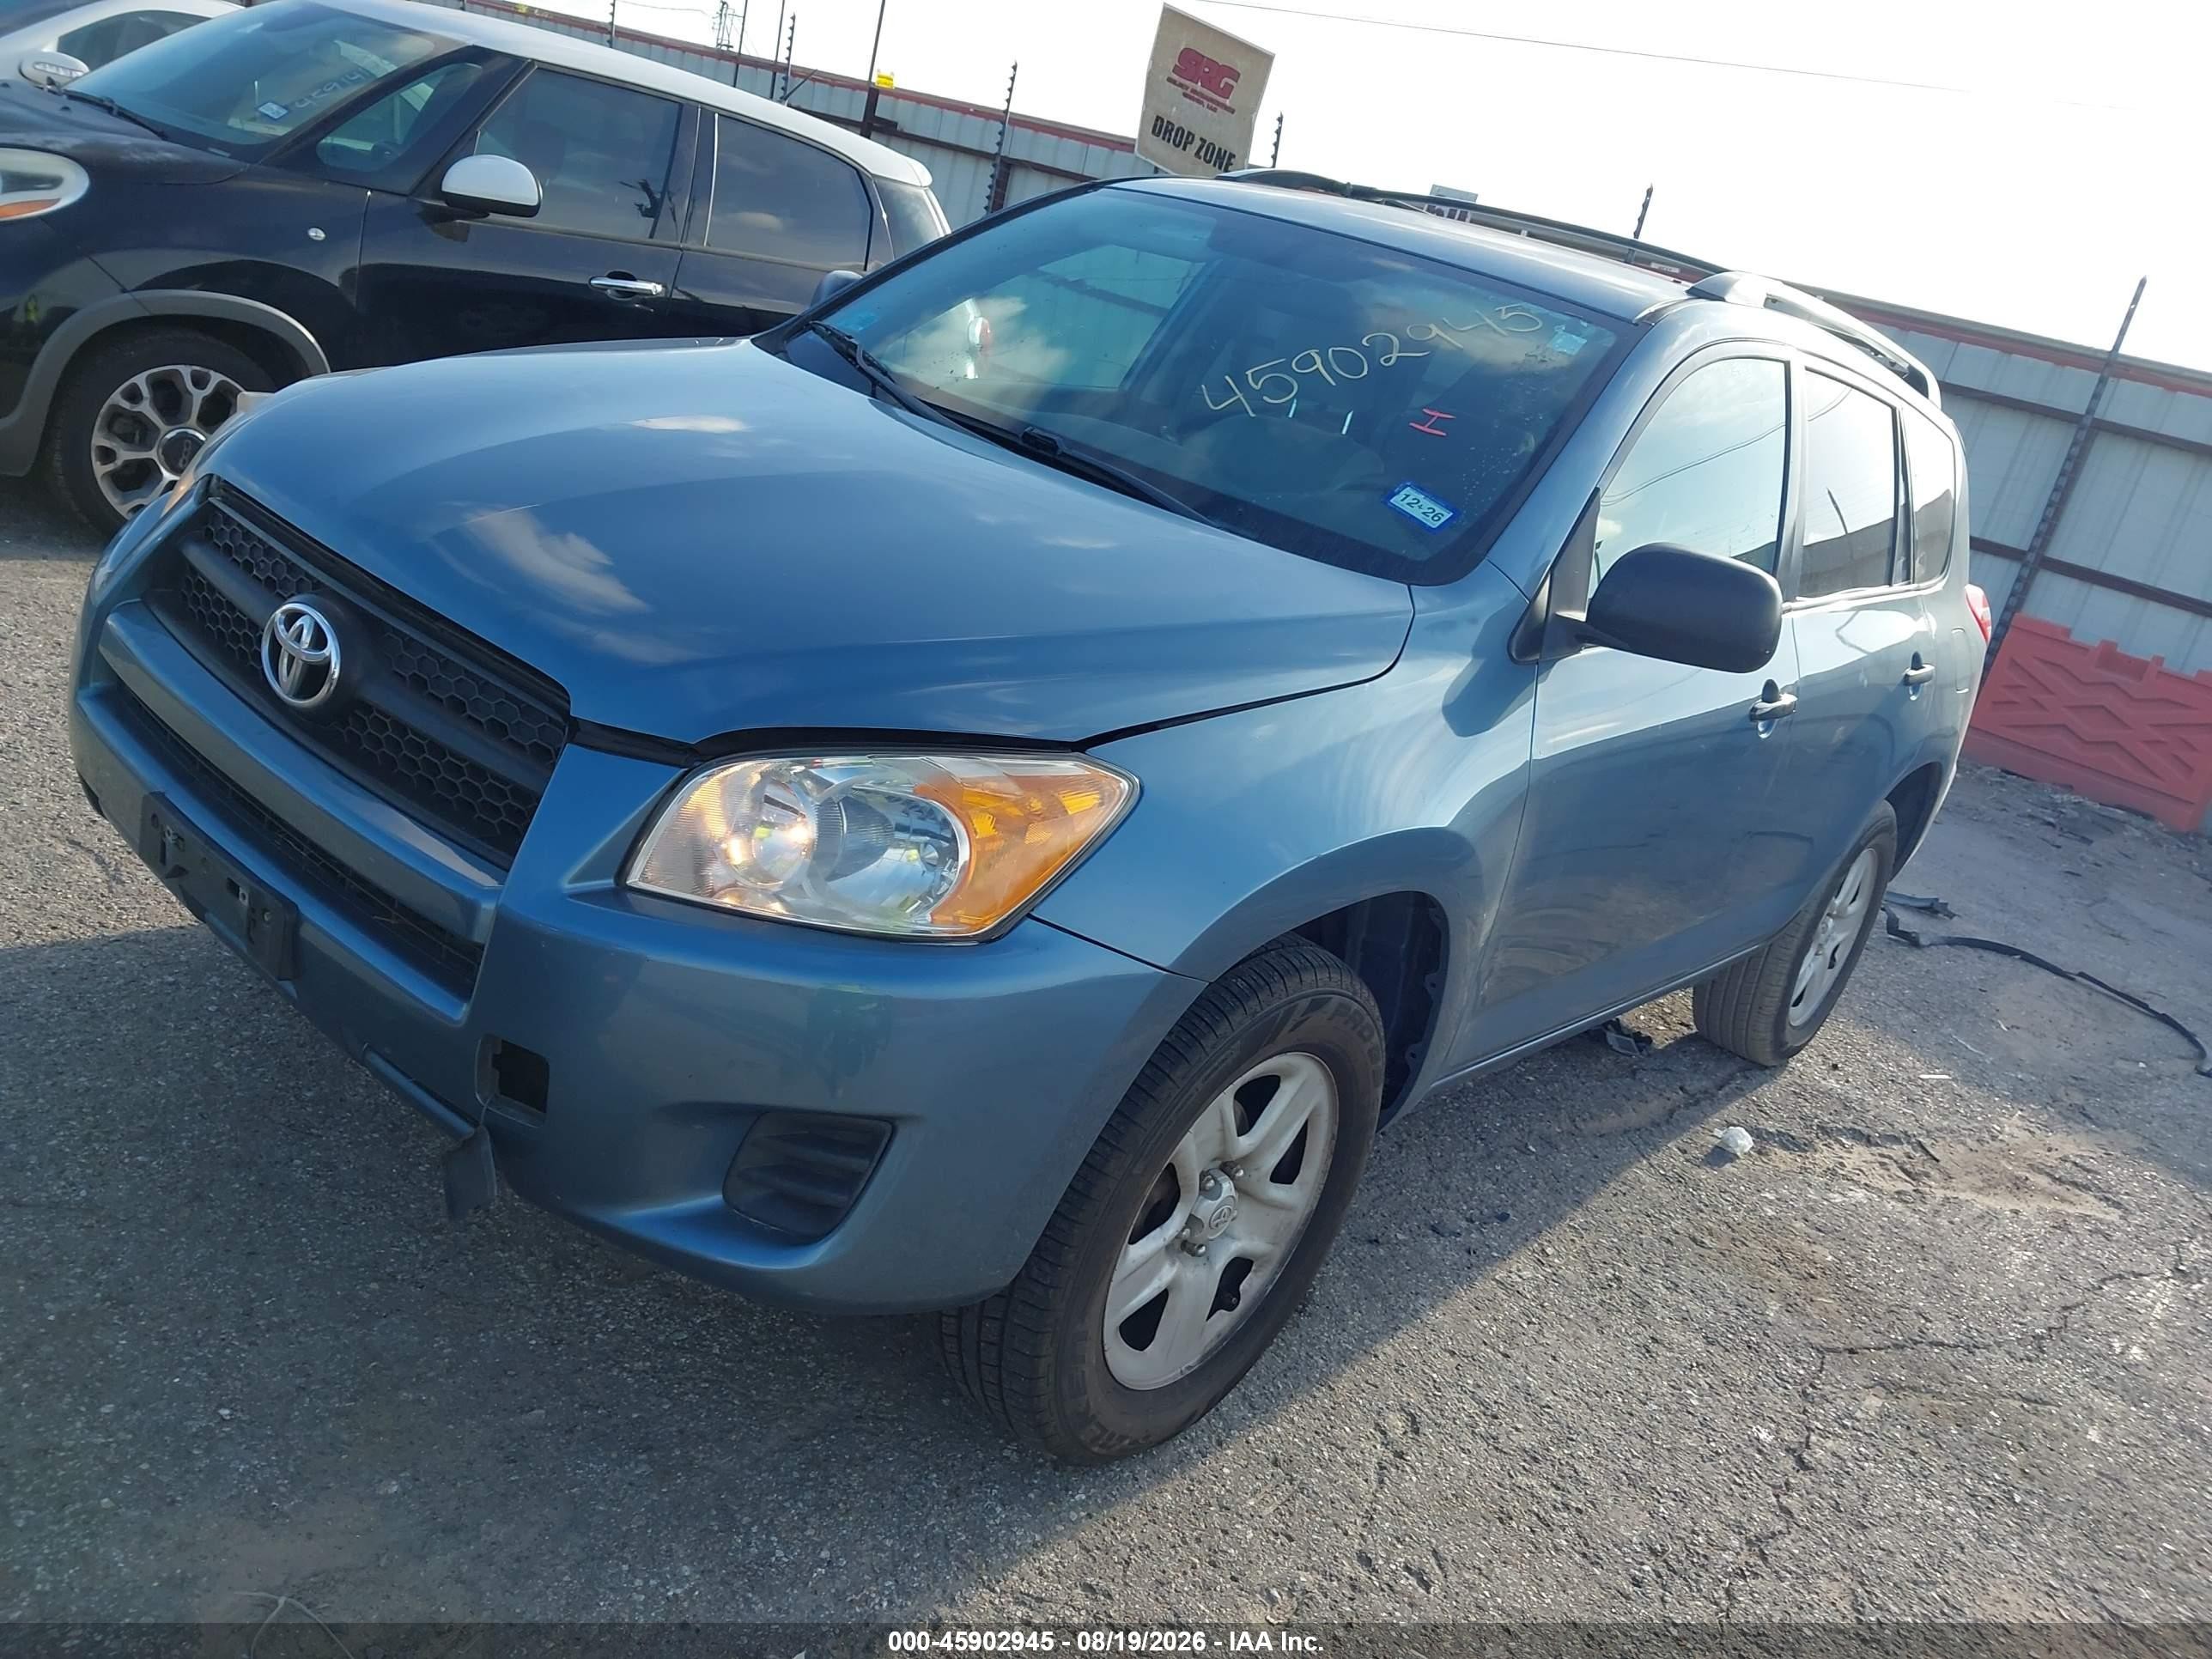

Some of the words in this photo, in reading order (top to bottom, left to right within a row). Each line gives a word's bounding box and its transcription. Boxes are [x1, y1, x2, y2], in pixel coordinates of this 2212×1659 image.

[1172, 47, 1241, 100] SRG
[1152, 115, 1194, 152] DROP
[1194, 137, 1236, 173] ZONE
[1200, 304, 1543, 418] 45902945
